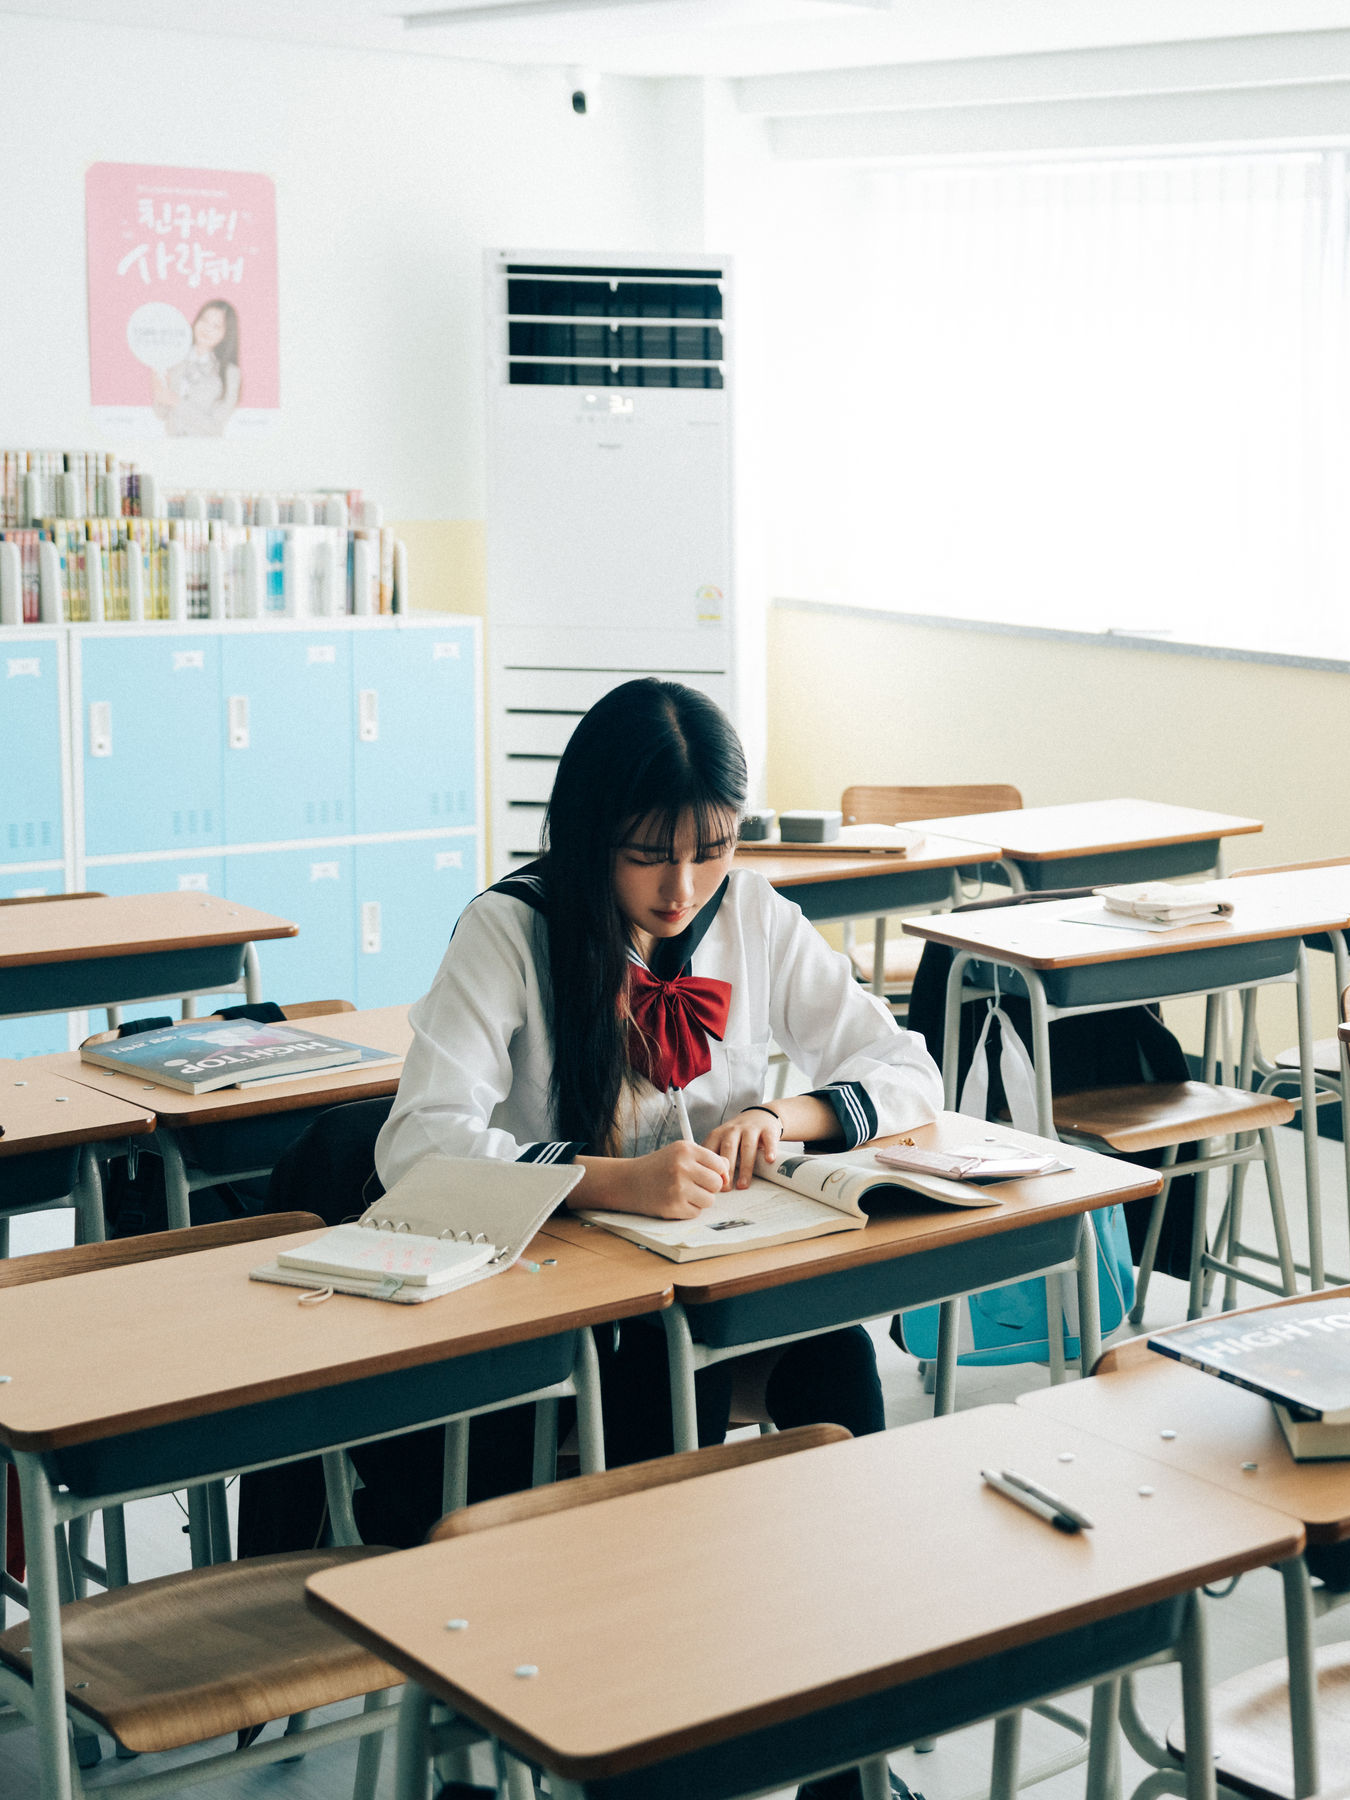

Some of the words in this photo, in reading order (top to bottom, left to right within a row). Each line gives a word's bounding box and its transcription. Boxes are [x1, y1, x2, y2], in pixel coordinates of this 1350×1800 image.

[138, 199, 238, 241] 친구야!
[117, 241, 245, 288] 사랑해
[180, 1055, 247, 1074] TOP
[240, 1041, 329, 1060] HIGH
[1197, 1323, 1311, 1359] HIGH
